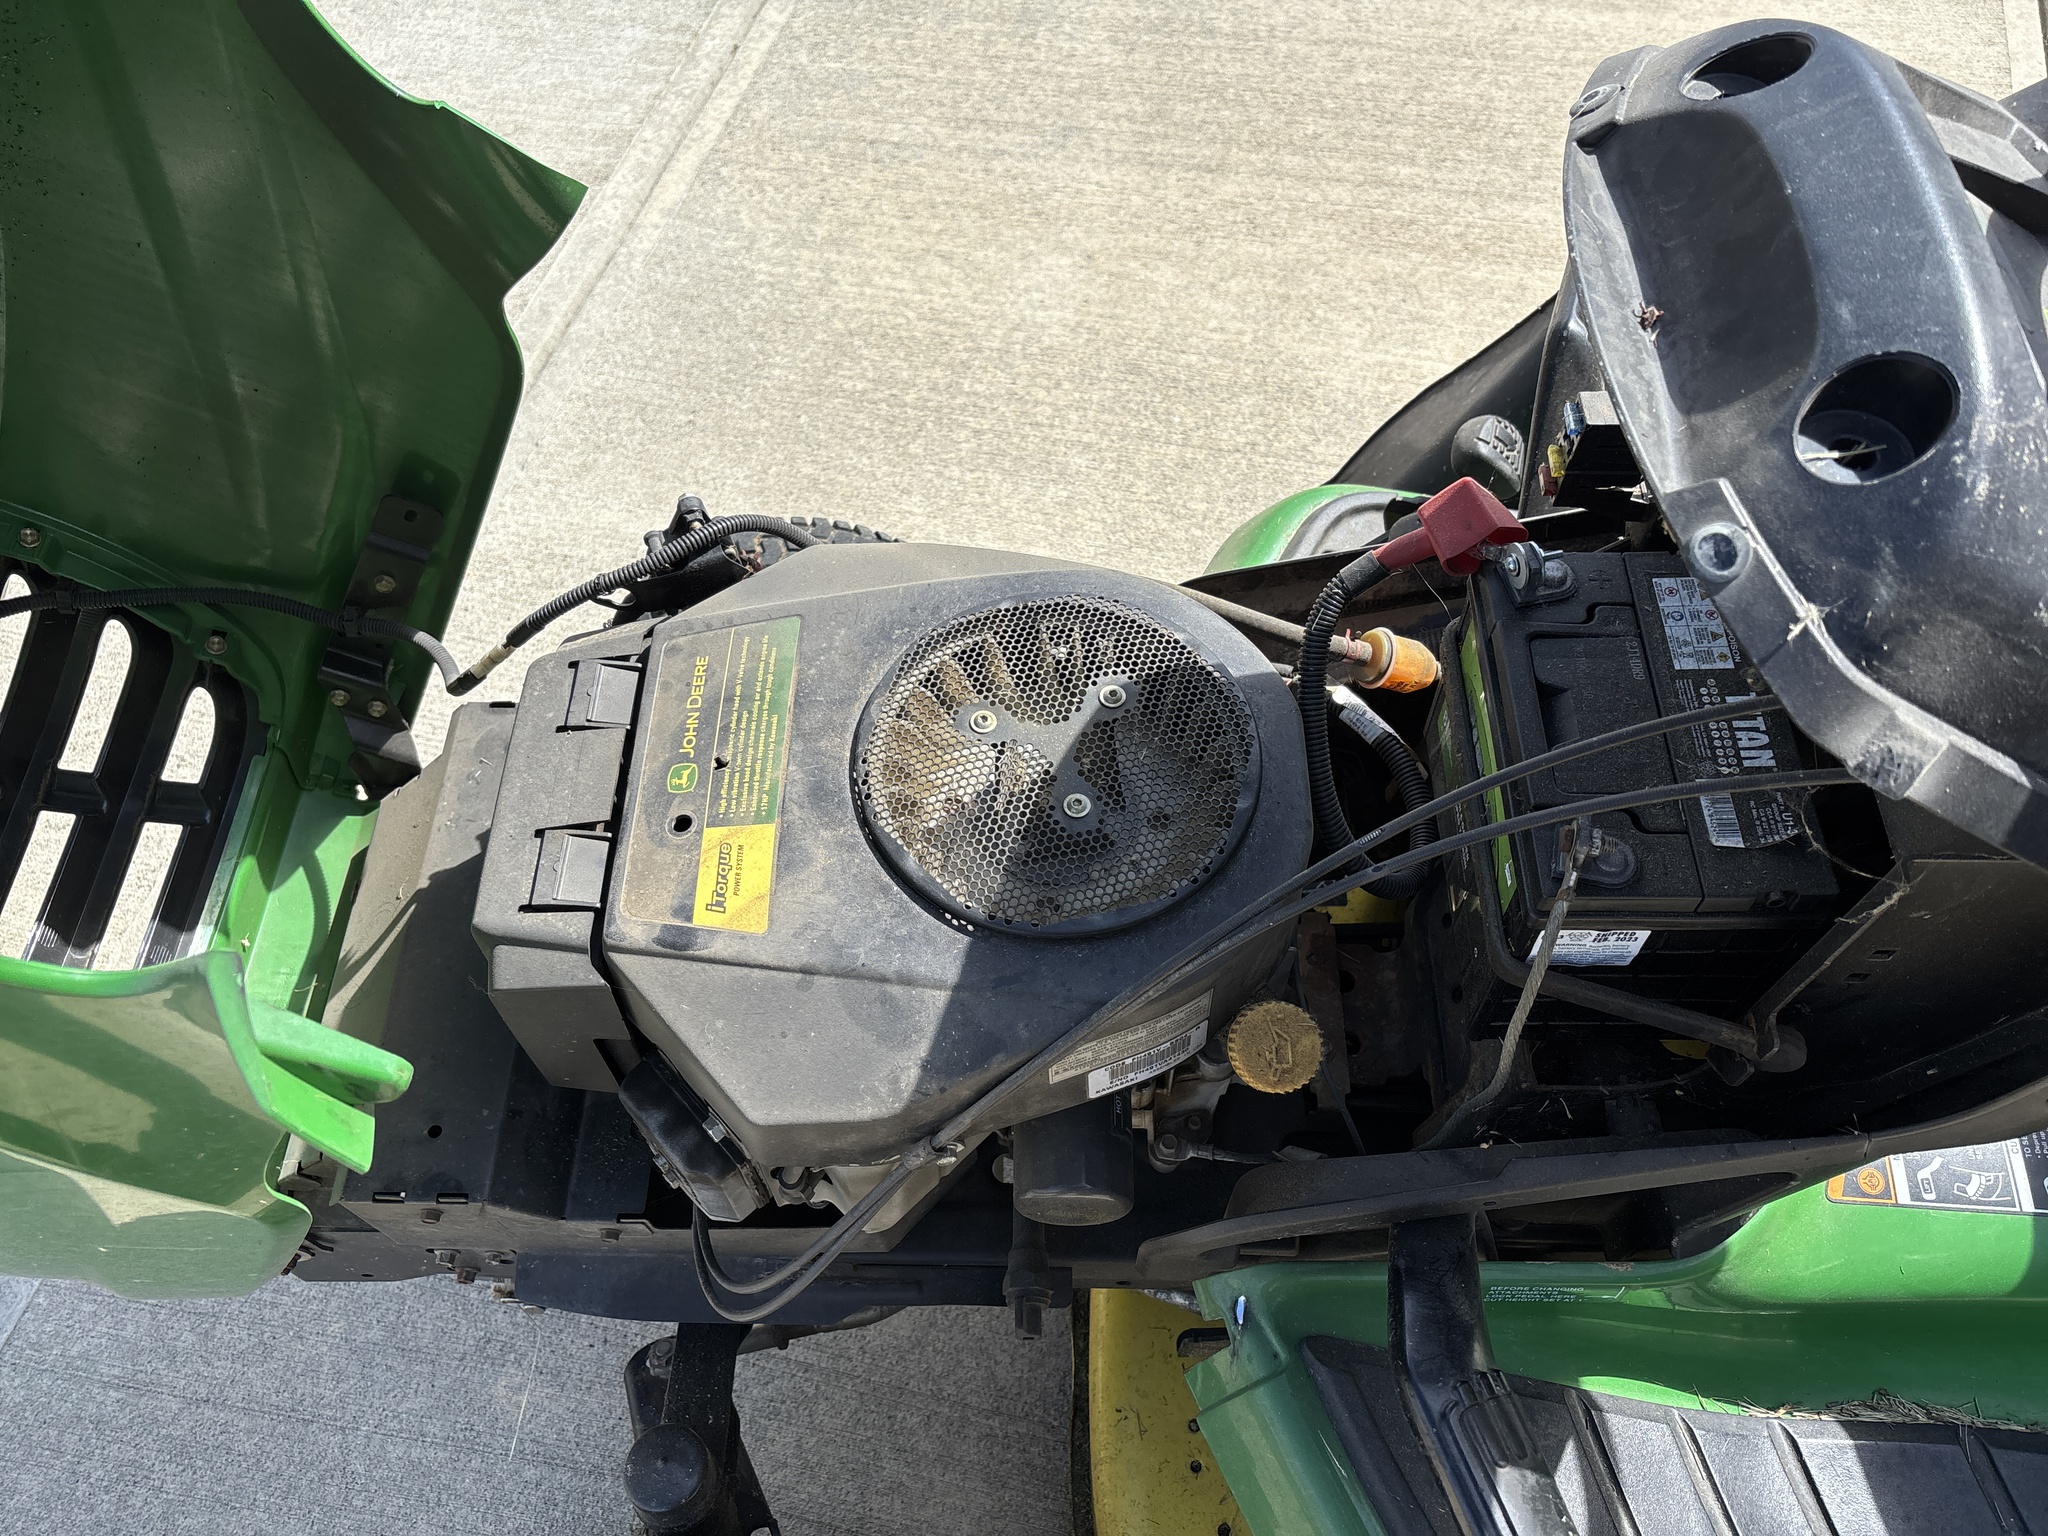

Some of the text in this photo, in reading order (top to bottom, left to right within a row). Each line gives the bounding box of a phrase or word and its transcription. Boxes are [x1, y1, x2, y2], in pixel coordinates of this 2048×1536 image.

[739, 635, 750, 663] technology
[767, 646, 777, 673] conditions
[734, 683, 742, 695] with
[765, 672, 774, 689] tough
[677, 654, 709, 758] JOHN DEERE
[732, 696, 740, 710] head
[752, 700, 761, 721] cooling
[729, 710, 738, 732] cylinder
[739, 709, 749, 729] design
[1725, 691, 1777, 768] TTAN
[736, 728, 746, 752] cylinder
[747, 720, 756, 746] channels
[744, 746, 754, 767] design
[757, 733, 766, 759] response
[753, 758, 762, 781] throttle
[760, 713, 778, 810] 17HP Manufactured by Kawasaki
[720, 768, 731, 798] efficiency
[730, 771, 740, 798] vibration
[742, 766, 751, 782] hood
[718, 797, 728, 814] High
[728, 798, 737, 813] Low
[739, 781, 749, 811] Exclusive
[749, 780, 759, 811] Enhanced
[704, 841, 733, 914] iTorque
[732, 843, 744, 896] POWER SYSTEM
[1103, 1060, 1126, 1072] CODE
[1094, 1075, 1138, 1094] KAWASAKI
[2022, 1145, 2033, 1158] TO
